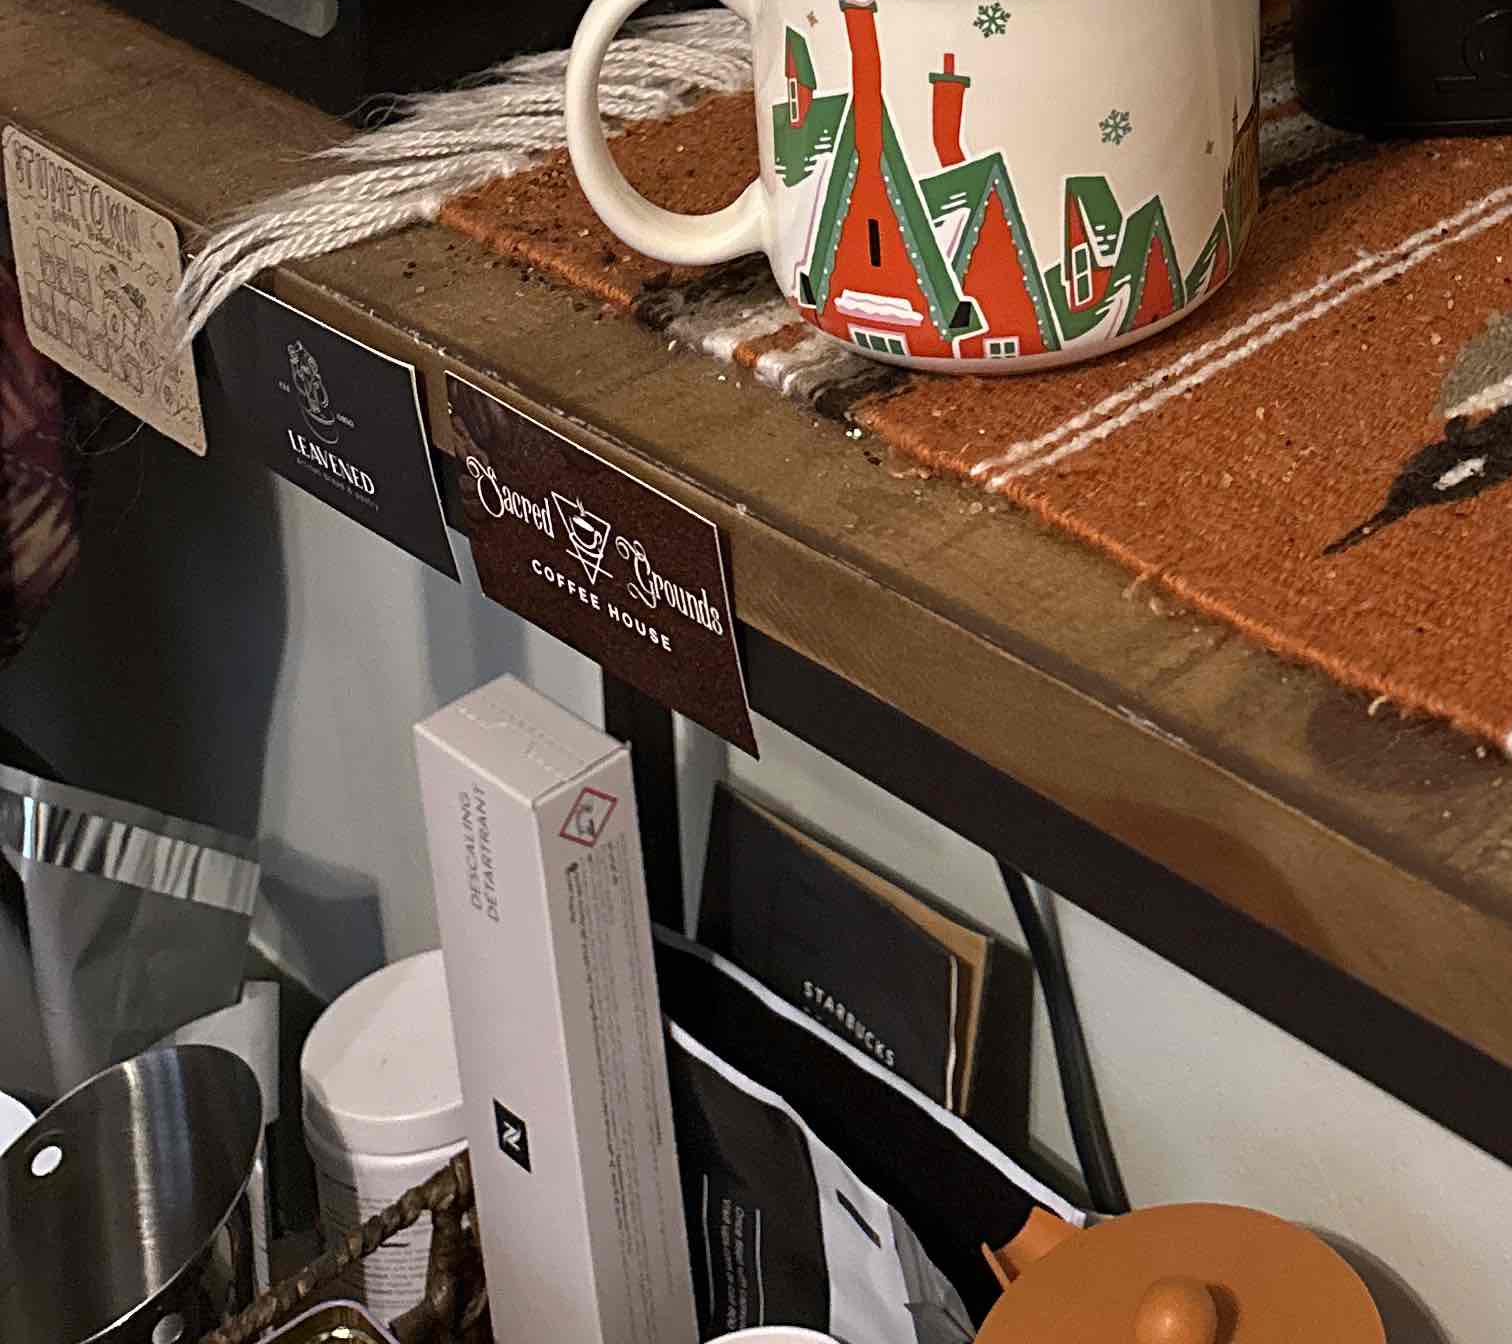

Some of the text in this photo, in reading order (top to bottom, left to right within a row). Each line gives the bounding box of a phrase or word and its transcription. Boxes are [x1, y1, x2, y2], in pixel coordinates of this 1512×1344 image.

[11, 140, 142, 251] STUMPTOWN
[287, 428, 376, 495] LEAVENED
[465, 454, 724, 637] Sacred Grounds
[531, 558, 673, 653] COFFEE HOUSE
[457, 790, 484, 911] DESCALING
[802, 980, 896, 1067] STARBUCKS
